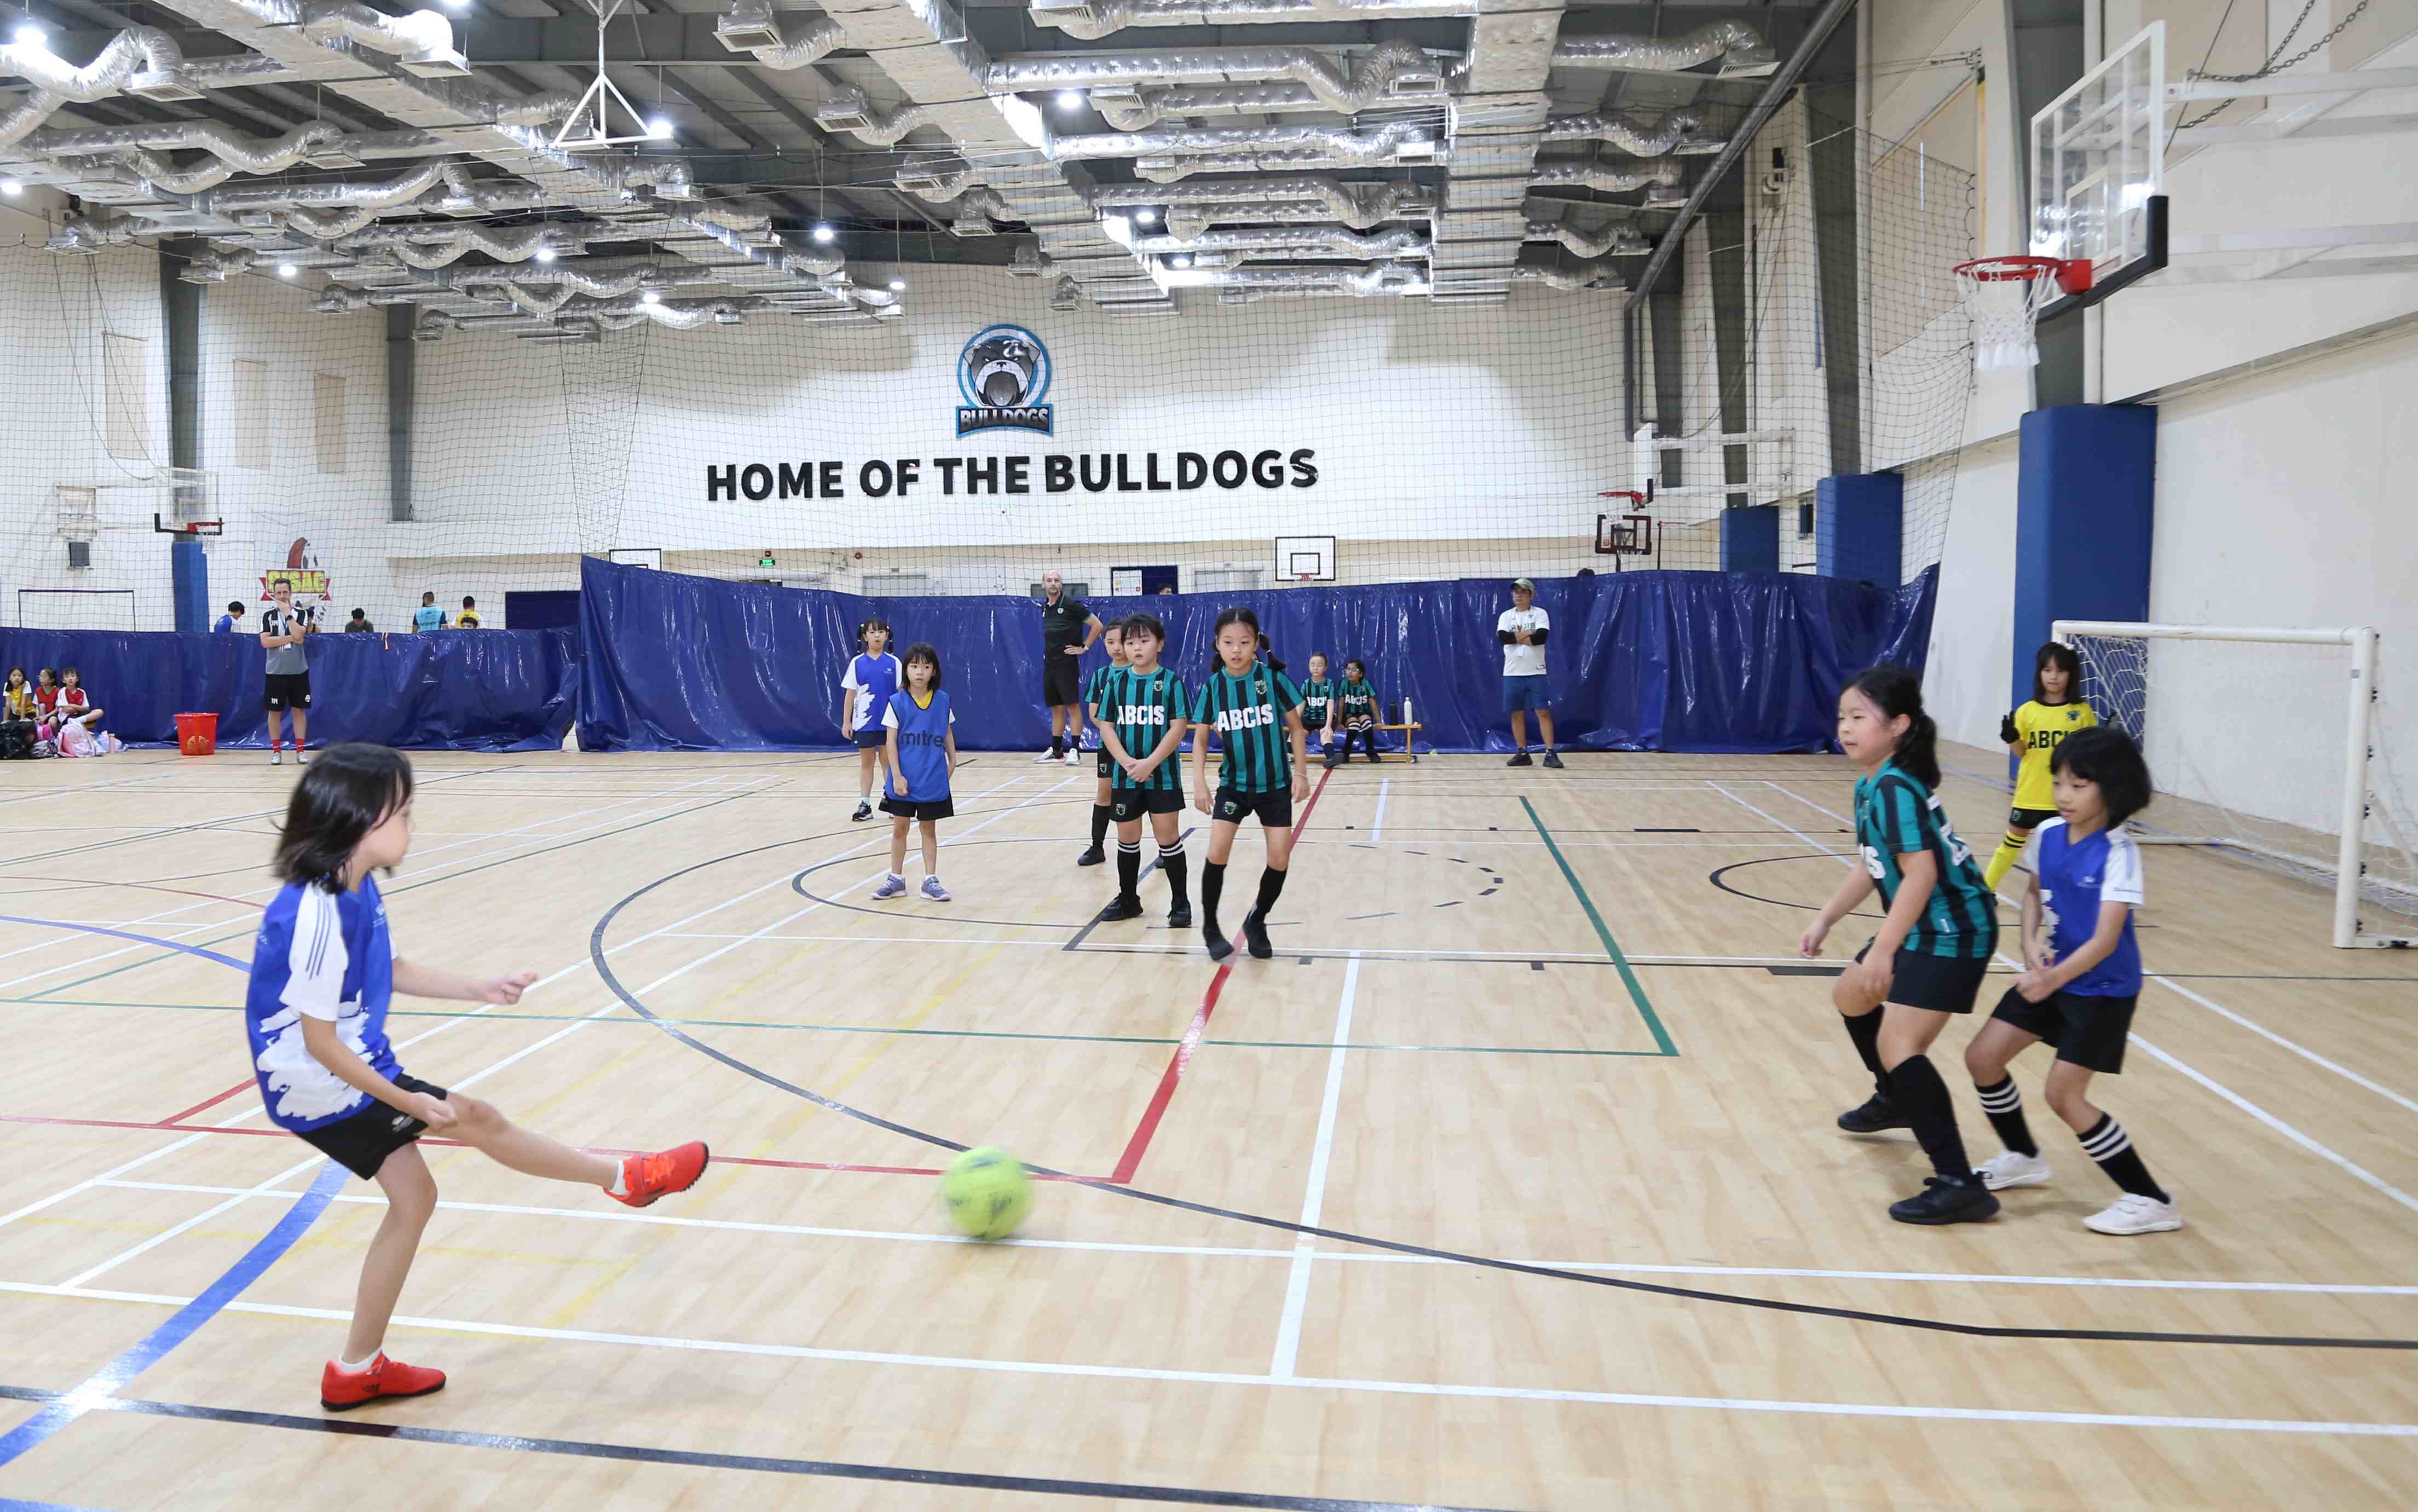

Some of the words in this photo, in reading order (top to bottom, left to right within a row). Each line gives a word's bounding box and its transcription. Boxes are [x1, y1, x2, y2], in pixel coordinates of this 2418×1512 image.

[960, 408, 1049, 428] BULLDOGS
[707, 461, 844, 501] HOME
[859, 458, 920, 498] OF
[933, 456, 1030, 495] THE
[1044, 448, 1319, 493] BULLDOGS
[1117, 705, 1165, 725] ABCIS
[1217, 703, 1274, 732] ABCIS
[900, 729, 944, 747] mitre
[2028, 730, 2069, 749] ABC
